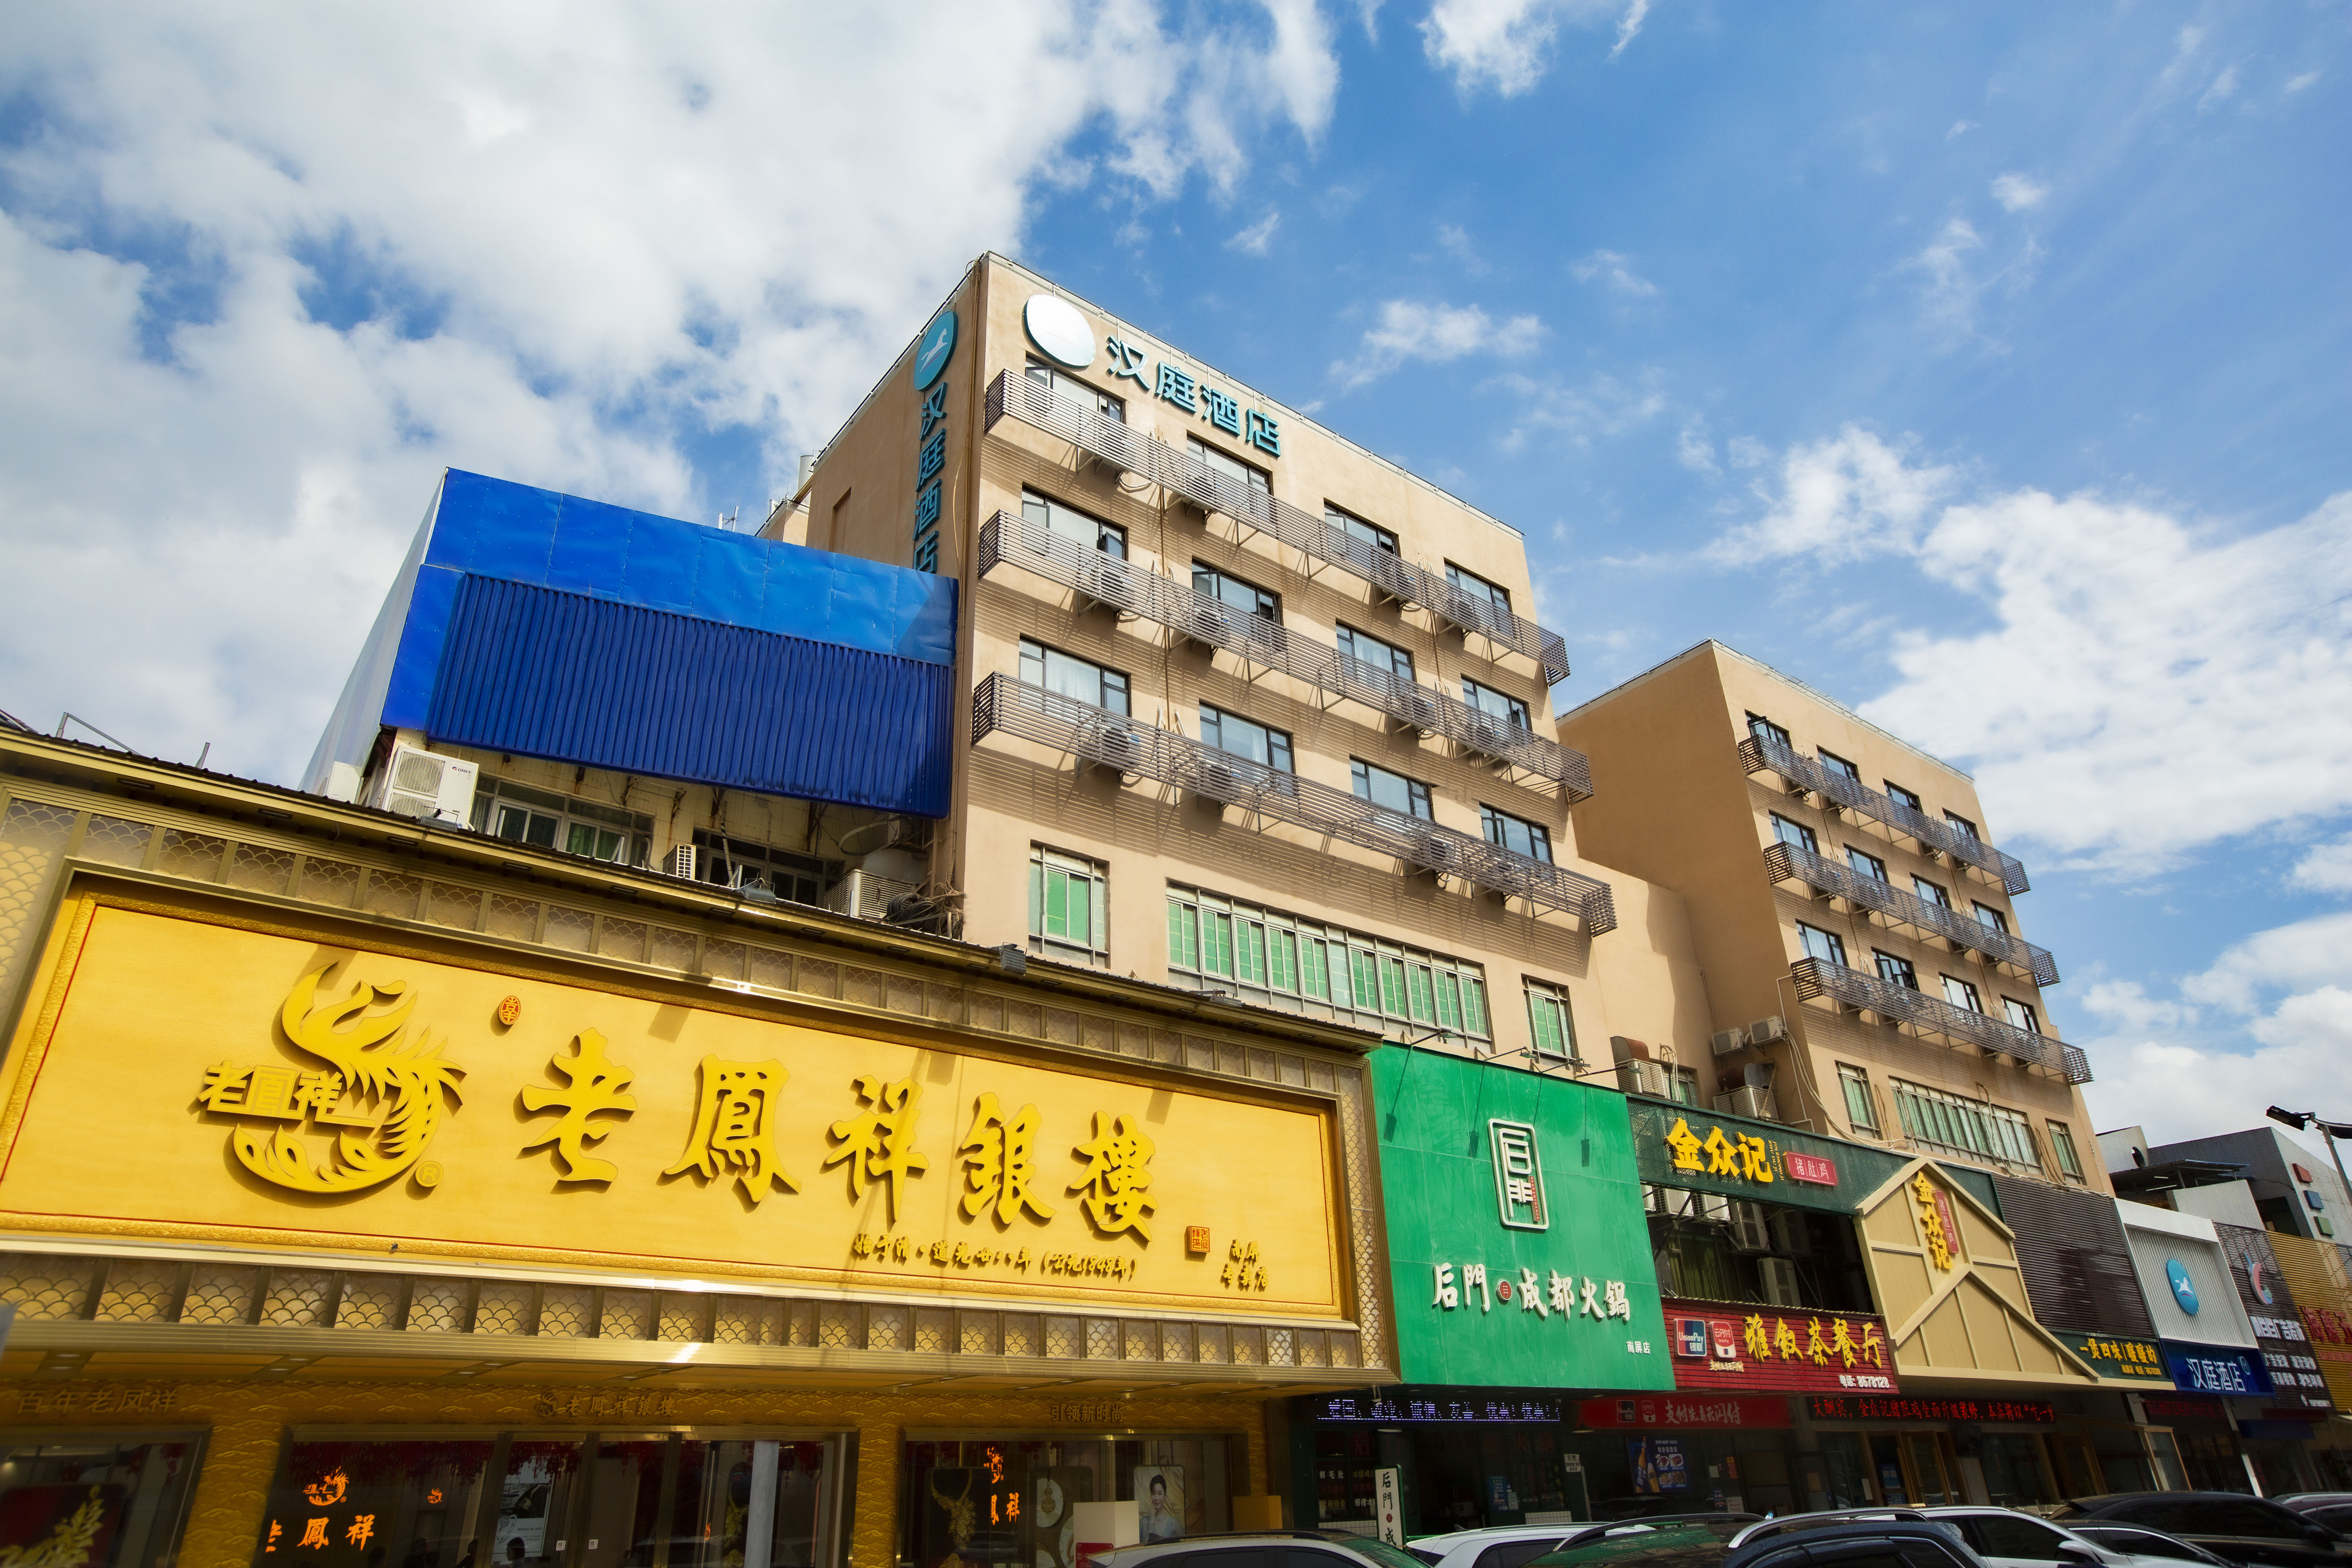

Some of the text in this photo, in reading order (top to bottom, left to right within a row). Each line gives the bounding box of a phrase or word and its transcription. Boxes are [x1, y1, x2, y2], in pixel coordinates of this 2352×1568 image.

[1106, 334, 1281, 457] 汉庭酒店
[913, 381, 948, 574] 汉庭酒店
[1664, 1117, 1774, 1183] 金众记
[1912, 1170, 1953, 1270] 金众记
[1231, 1239, 1261, 1260] 南屏
[1223, 1263, 1269, 1287] 专卖店
[1626, 1341, 1650, 1354] 南屏店
[1679, 1331, 1704, 1345] UnionPay
[1690, 1342, 1704, 1352] 银联
[2186, 1357, 2246, 1392] 汉庭酒店
[18, 1388, 178, 1414] 百年老凤祥
[1052, 1405, 1123, 1422] 引领新时尚
[1319, 1470, 1344, 1479] 鲜毛肚
